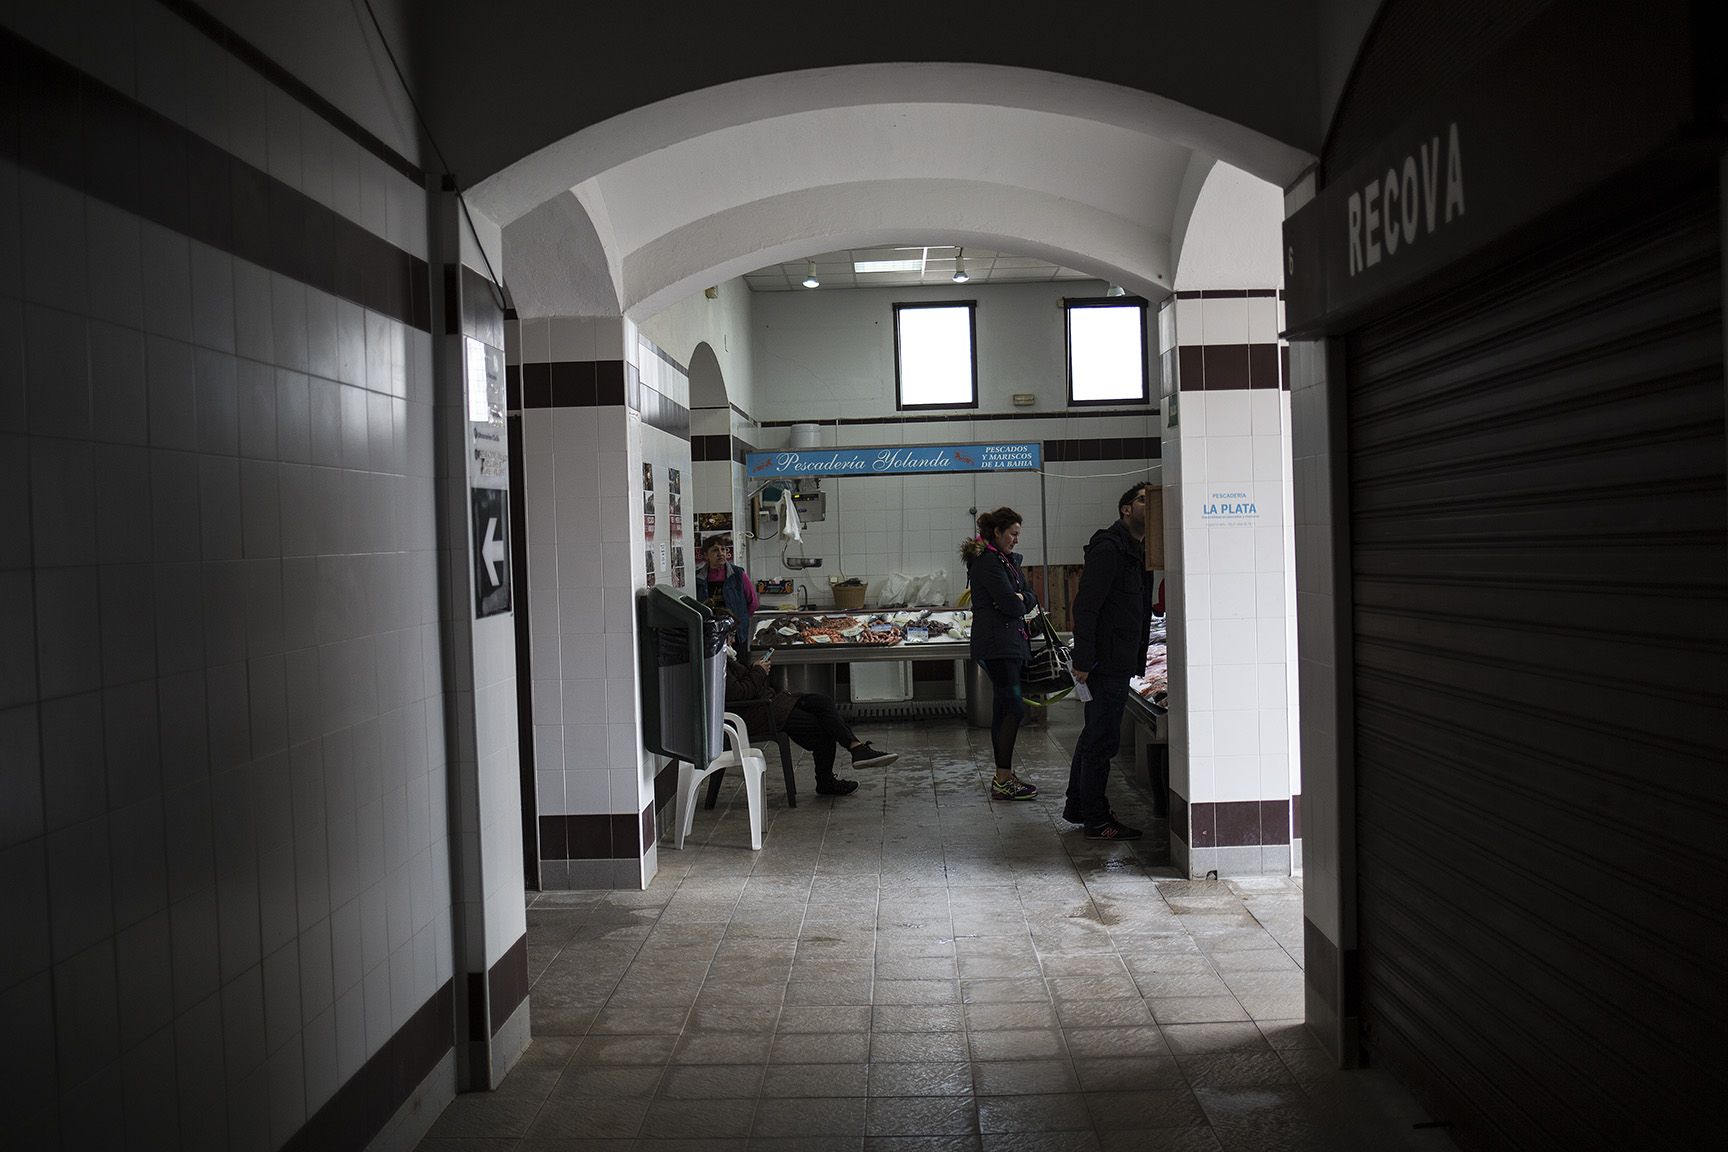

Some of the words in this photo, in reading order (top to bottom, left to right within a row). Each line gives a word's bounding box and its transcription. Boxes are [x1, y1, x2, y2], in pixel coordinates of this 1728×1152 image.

[1347, 121, 1466, 277] RECOVA
[985, 445, 1028, 453] PESCADOS
[775, 452, 866, 473] Pescadería
[872, 448, 951, 472] Yolanda
[989, 453, 1032, 461] MARISCOS
[1203, 504, 1218, 515] LA
[1221, 503, 1257, 514] PLATA
